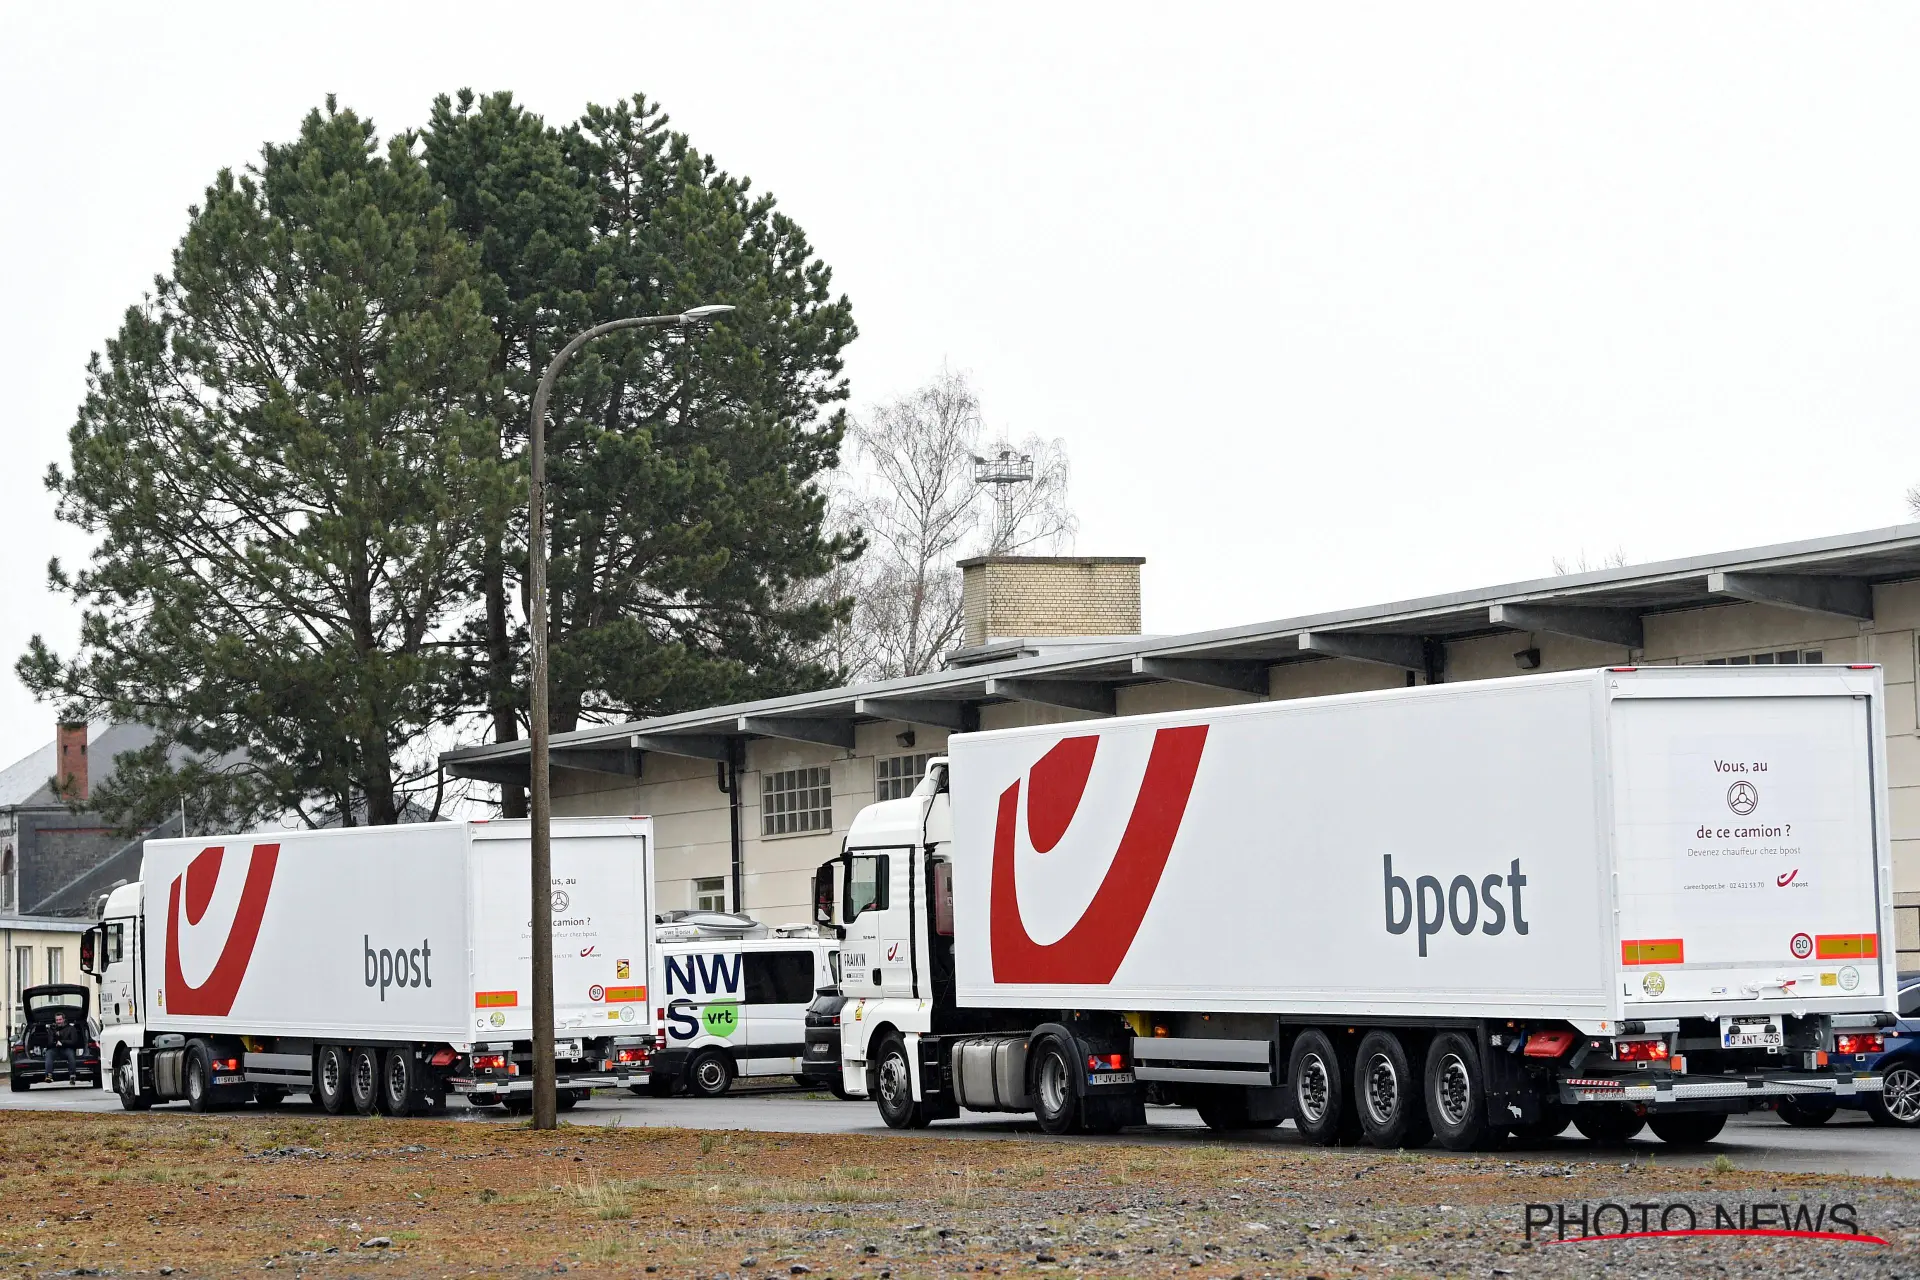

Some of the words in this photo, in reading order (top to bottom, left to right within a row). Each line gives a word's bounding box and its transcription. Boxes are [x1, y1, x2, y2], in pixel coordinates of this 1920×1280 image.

[1714, 760, 1749, 774] Vous,
[1752, 761, 1768, 772] au
[1696, 825, 1712, 838] de
[1716, 828, 1730, 838] ce
[1734, 825, 1782, 838] camion
[1785, 824, 1791, 837] ?
[1687, 848, 1719, 857] Devenez
[1722, 847, 1758, 856] chauffeur
[1760, 847, 1777, 855] chez
[1780, 846, 1801, 856] bpost
[551, 878, 564, 886] us,
[1383, 854, 1529, 957] bpost
[552, 918, 585, 927] camion
[1795, 939, 1808, 949] 60
[364, 934, 432, 1002] bpost
[664, 953, 743, 995] NW
[592, 988, 601, 996] 60
[1623, 983, 1633, 996] L
[476, 1018, 484, 1028] C
[667, 998, 700, 1040] S
[707, 1009, 734, 1025] vrt
